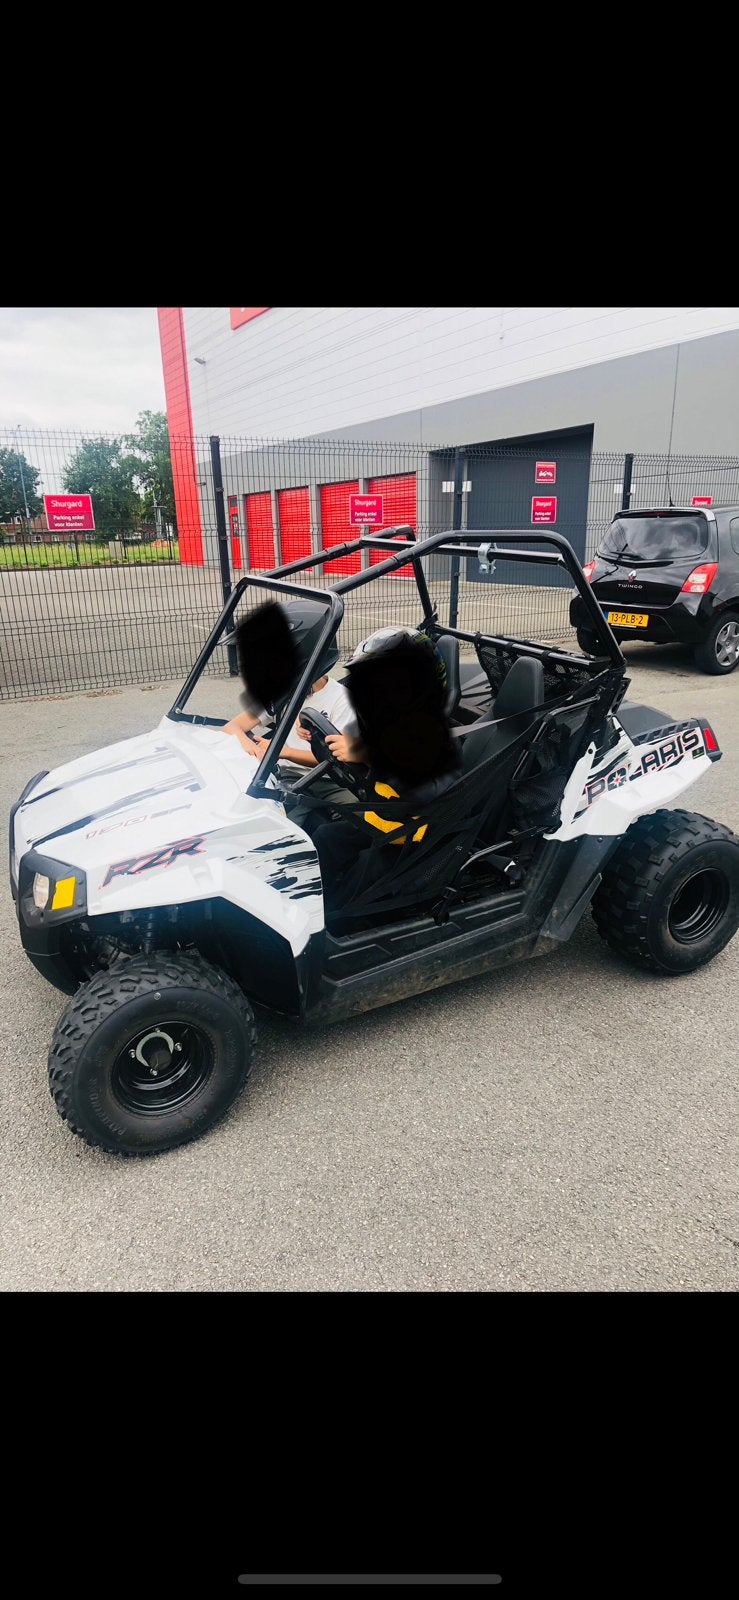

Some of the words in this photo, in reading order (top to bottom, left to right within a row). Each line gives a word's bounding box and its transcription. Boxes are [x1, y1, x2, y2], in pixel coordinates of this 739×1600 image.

[50, 500, 83, 509] Shurgard
[354, 499, 377, 507] Shurgard
[611, 613, 644, 625] 13-PLB-2
[586, 728, 700, 805] POLARIS
[99, 836, 207, 889] RZR
